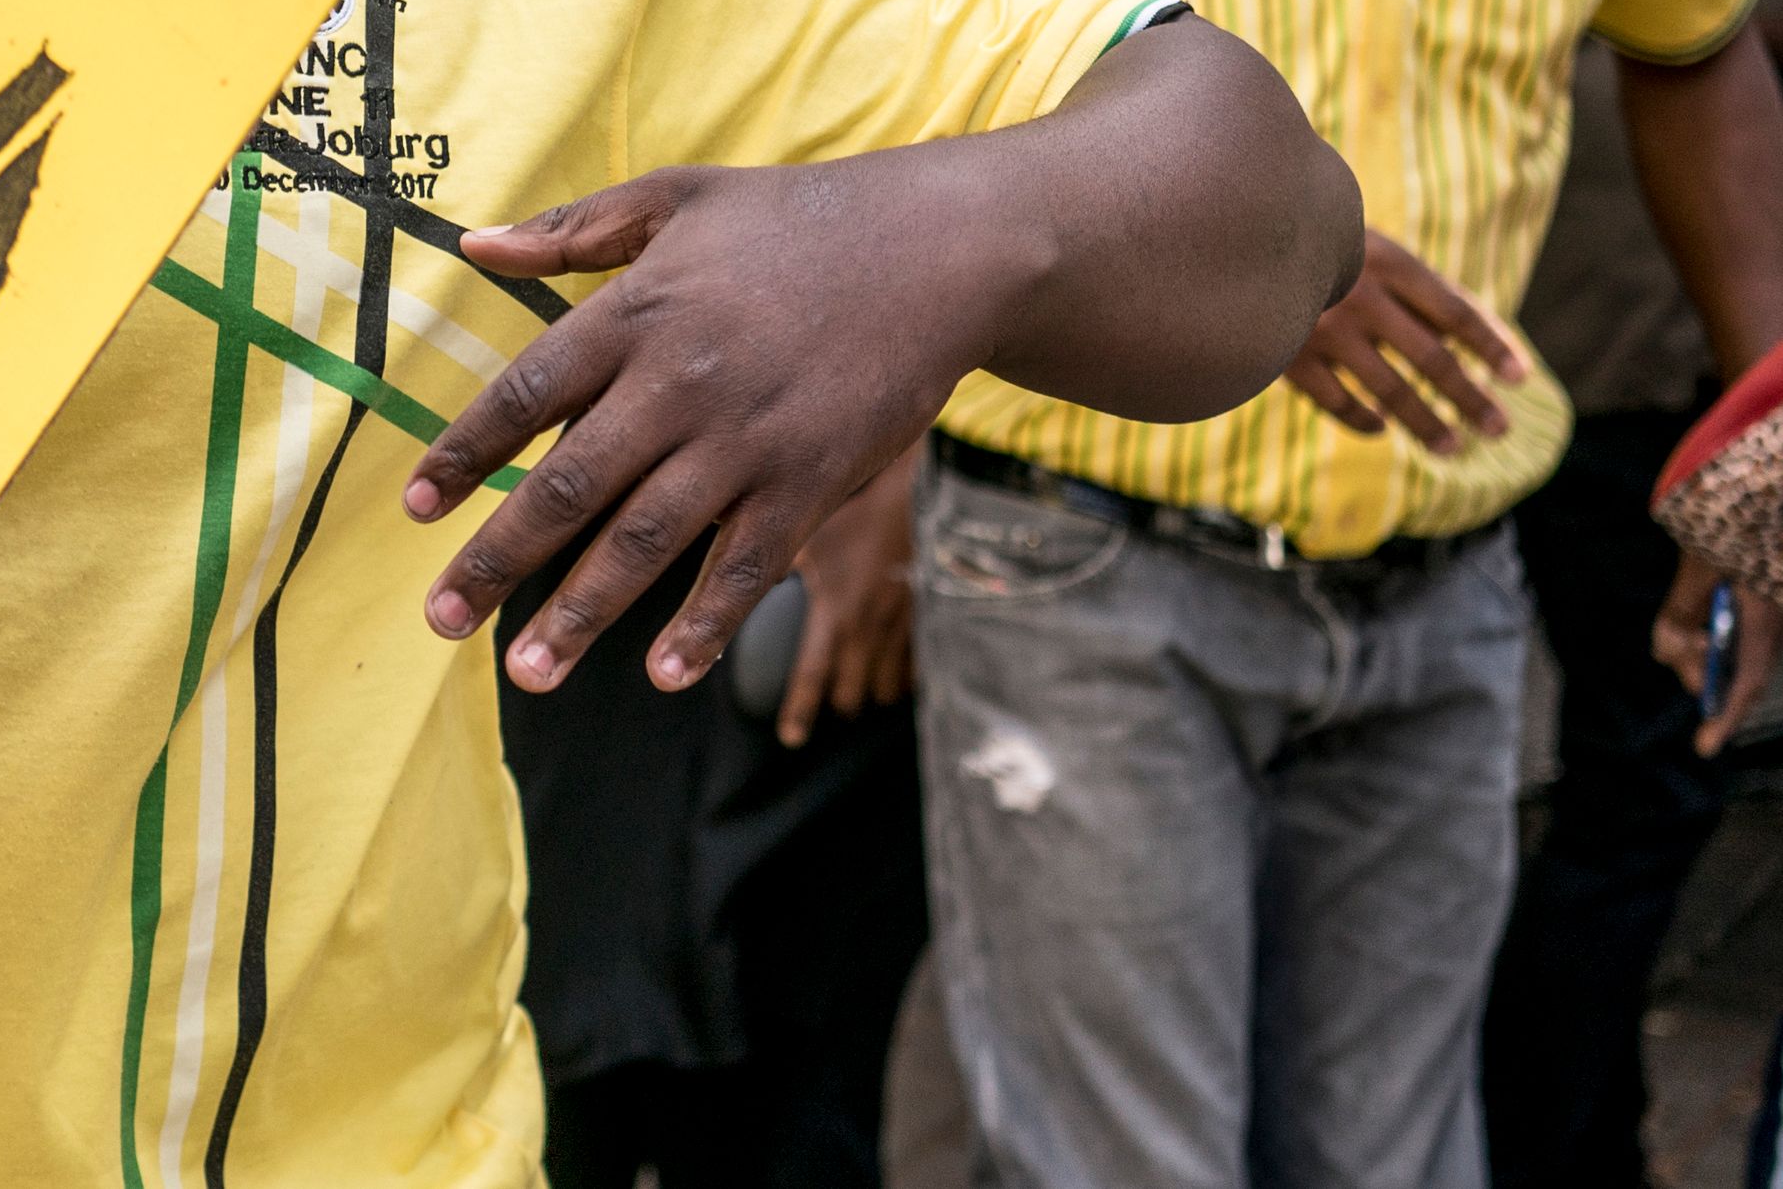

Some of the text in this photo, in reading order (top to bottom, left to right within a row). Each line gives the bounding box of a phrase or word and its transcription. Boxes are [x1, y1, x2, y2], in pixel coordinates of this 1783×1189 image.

[296, 40, 367, 77] NC
[269, 86, 396, 120] NE 11
[301, 122, 451, 169] Joburg
[242, 165, 373, 194] December
[388, 172, 439, 199] 2017
